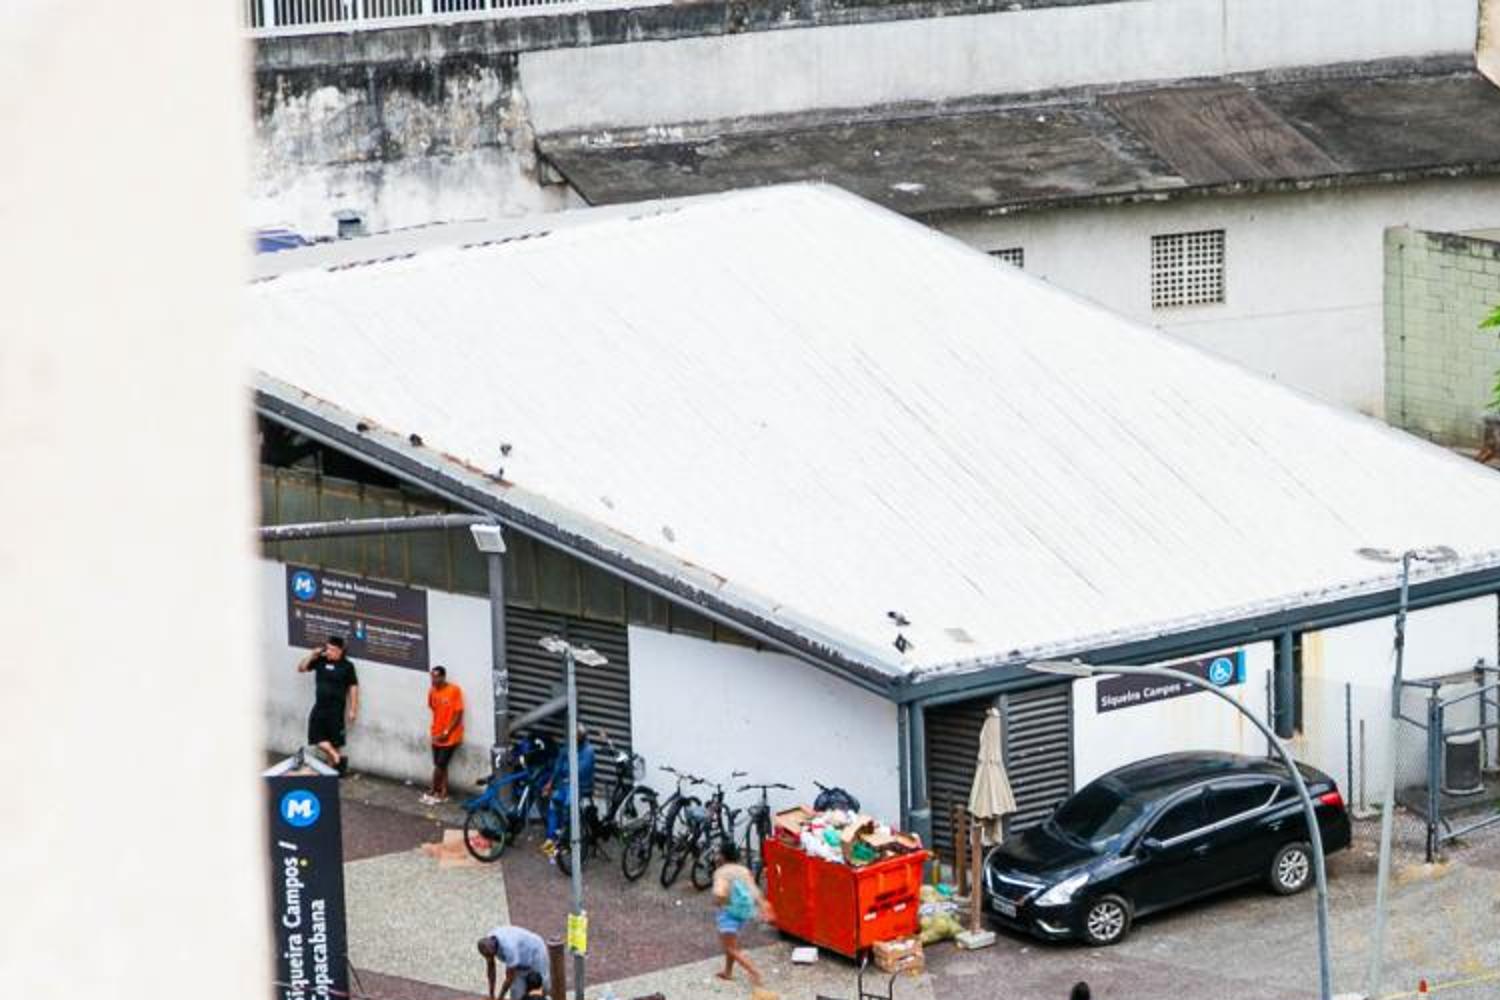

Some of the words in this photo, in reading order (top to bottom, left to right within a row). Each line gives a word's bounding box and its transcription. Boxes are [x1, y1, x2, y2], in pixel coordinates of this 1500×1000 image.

[1101, 690, 1141, 707] Siqueira
[1143, 683, 1181, 699] Campos
[283, 855, 305, 929] Campos
